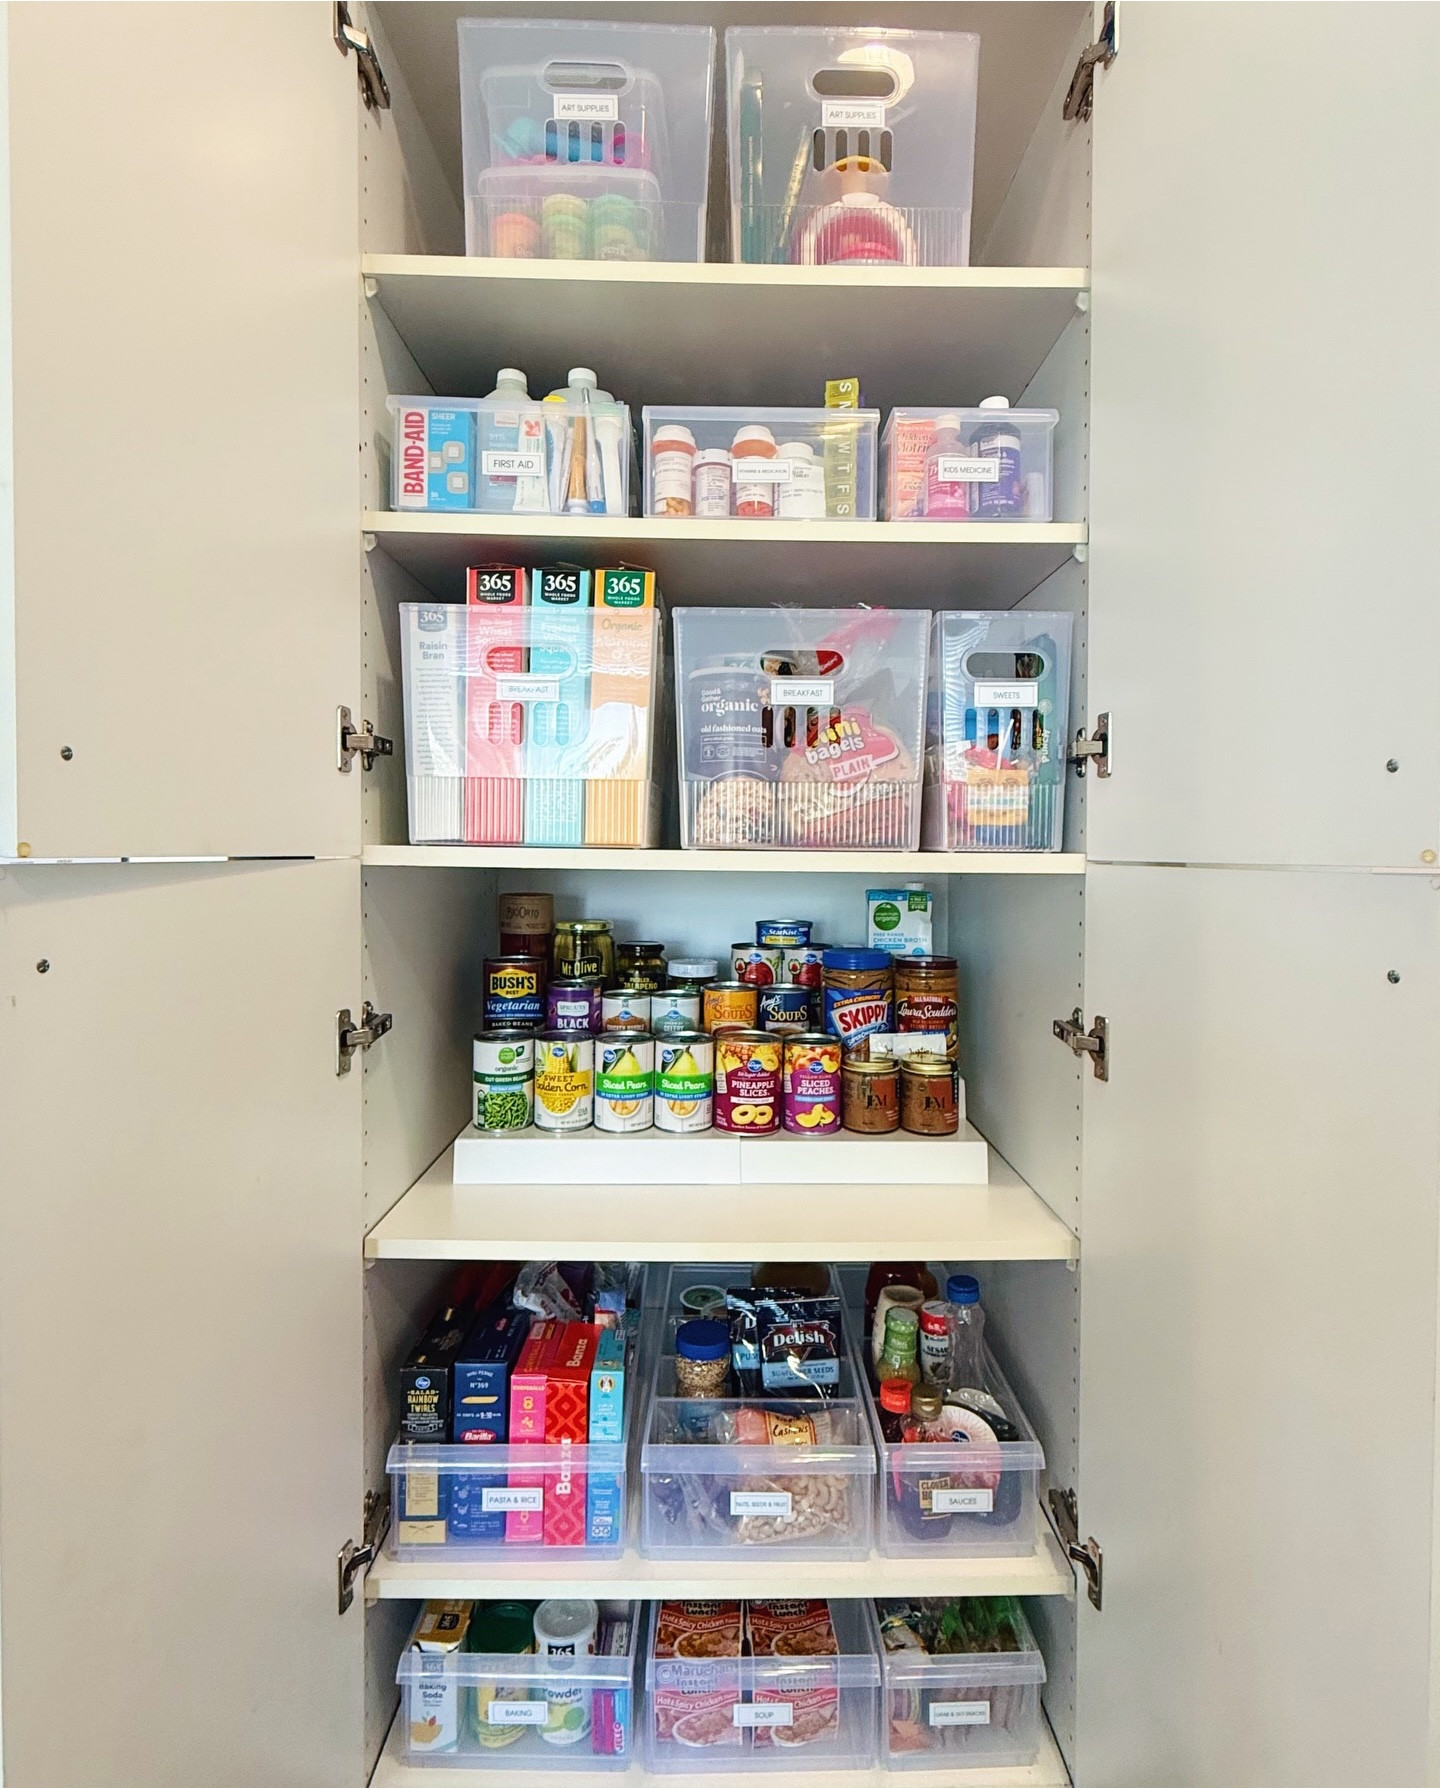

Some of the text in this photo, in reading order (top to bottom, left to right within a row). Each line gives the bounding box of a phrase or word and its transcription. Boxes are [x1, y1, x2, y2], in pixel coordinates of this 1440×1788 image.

[561, 104, 609, 113] ART SUPPLIES
[829, 111, 876, 119] ART SUPPLIES
[840, 381, 852, 393] S
[431, 412, 456, 420] SHEER
[404, 411, 425, 494] BAND-AID
[838, 442, 850, 454] W
[493, 460, 534, 469] FIRST AID
[838, 484, 850, 494] F
[837, 504, 849, 515] S
[480, 574, 511, 592] 365
[544, 574, 577, 592] 365
[607, 577, 641, 595] 365
[421, 611, 444, 623] 365
[602, 618, 643, 632] Organic
[419, 641, 447, 650] Raisin
[422, 651, 445, 660] Bran
[783, 689, 823, 697] BREAKFAST
[993, 691, 1020, 699] SWEETS
[701, 698, 759, 717] organic
[701, 725, 711, 733] old
[712, 724, 751, 733] fashioned
[805, 737, 865, 765] bagels
[833, 757, 870, 779] PLAIN
[574, 960, 597, 976] Olive
[491, 975, 535, 991] BUSH'S
[486, 1000, 540, 1013] Vegetarian
[898, 1002, 922, 1017] Laura
[769, 1005, 807, 1021] SOUPS
[838, 1004, 887, 1033] SKIPPY
[557, 1018, 589, 1029] BLACK
[494, 1064, 518, 1073] organic
[543, 1074, 575, 1083] SWEET
[801, 1079, 831, 1087] SLICED
[564, 1082, 587, 1092] Corn
[603, 1079, 648, 1090] Sliced Pears
[662, 1079, 706, 1091] Sliced Pears
[731, 1080, 774, 1089] PINEAPPLE
[739, 1089, 768, 1097] SLICES
[797, 1086, 834, 1095] PEACHES
[773, 1330, 825, 1347] Delish
[566, 1338, 588, 1367] Banza
[407, 1395, 439, 1404] RAINBOW
[410, 1404, 436, 1413] TWIRLS
[464, 1432, 494, 1441] Barilla
[489, 1496, 537, 1504] PASTA & RICE
[949, 1497, 977, 1505] SAUCES
[686, 1607, 717, 1616] Lunch
[768, 1602, 808, 1610] Instant
[773, 1608, 806, 1616] Lunch
[678, 1617, 697, 1630] Spicy
[698, 1617, 725, 1629] Chicken
[769, 1619, 787, 1631] Spicy
[788, 1617, 814, 1630] Chicken
[671, 1663, 735, 1676] Maruchan
[418, 1683, 447, 1692] Baking
[422, 1691, 443, 1699] Soda
[673, 1698, 693, 1710] Spicy
[694, 1696, 722, 1709] Chicken
[795, 1697, 820, 1708] Chicken
